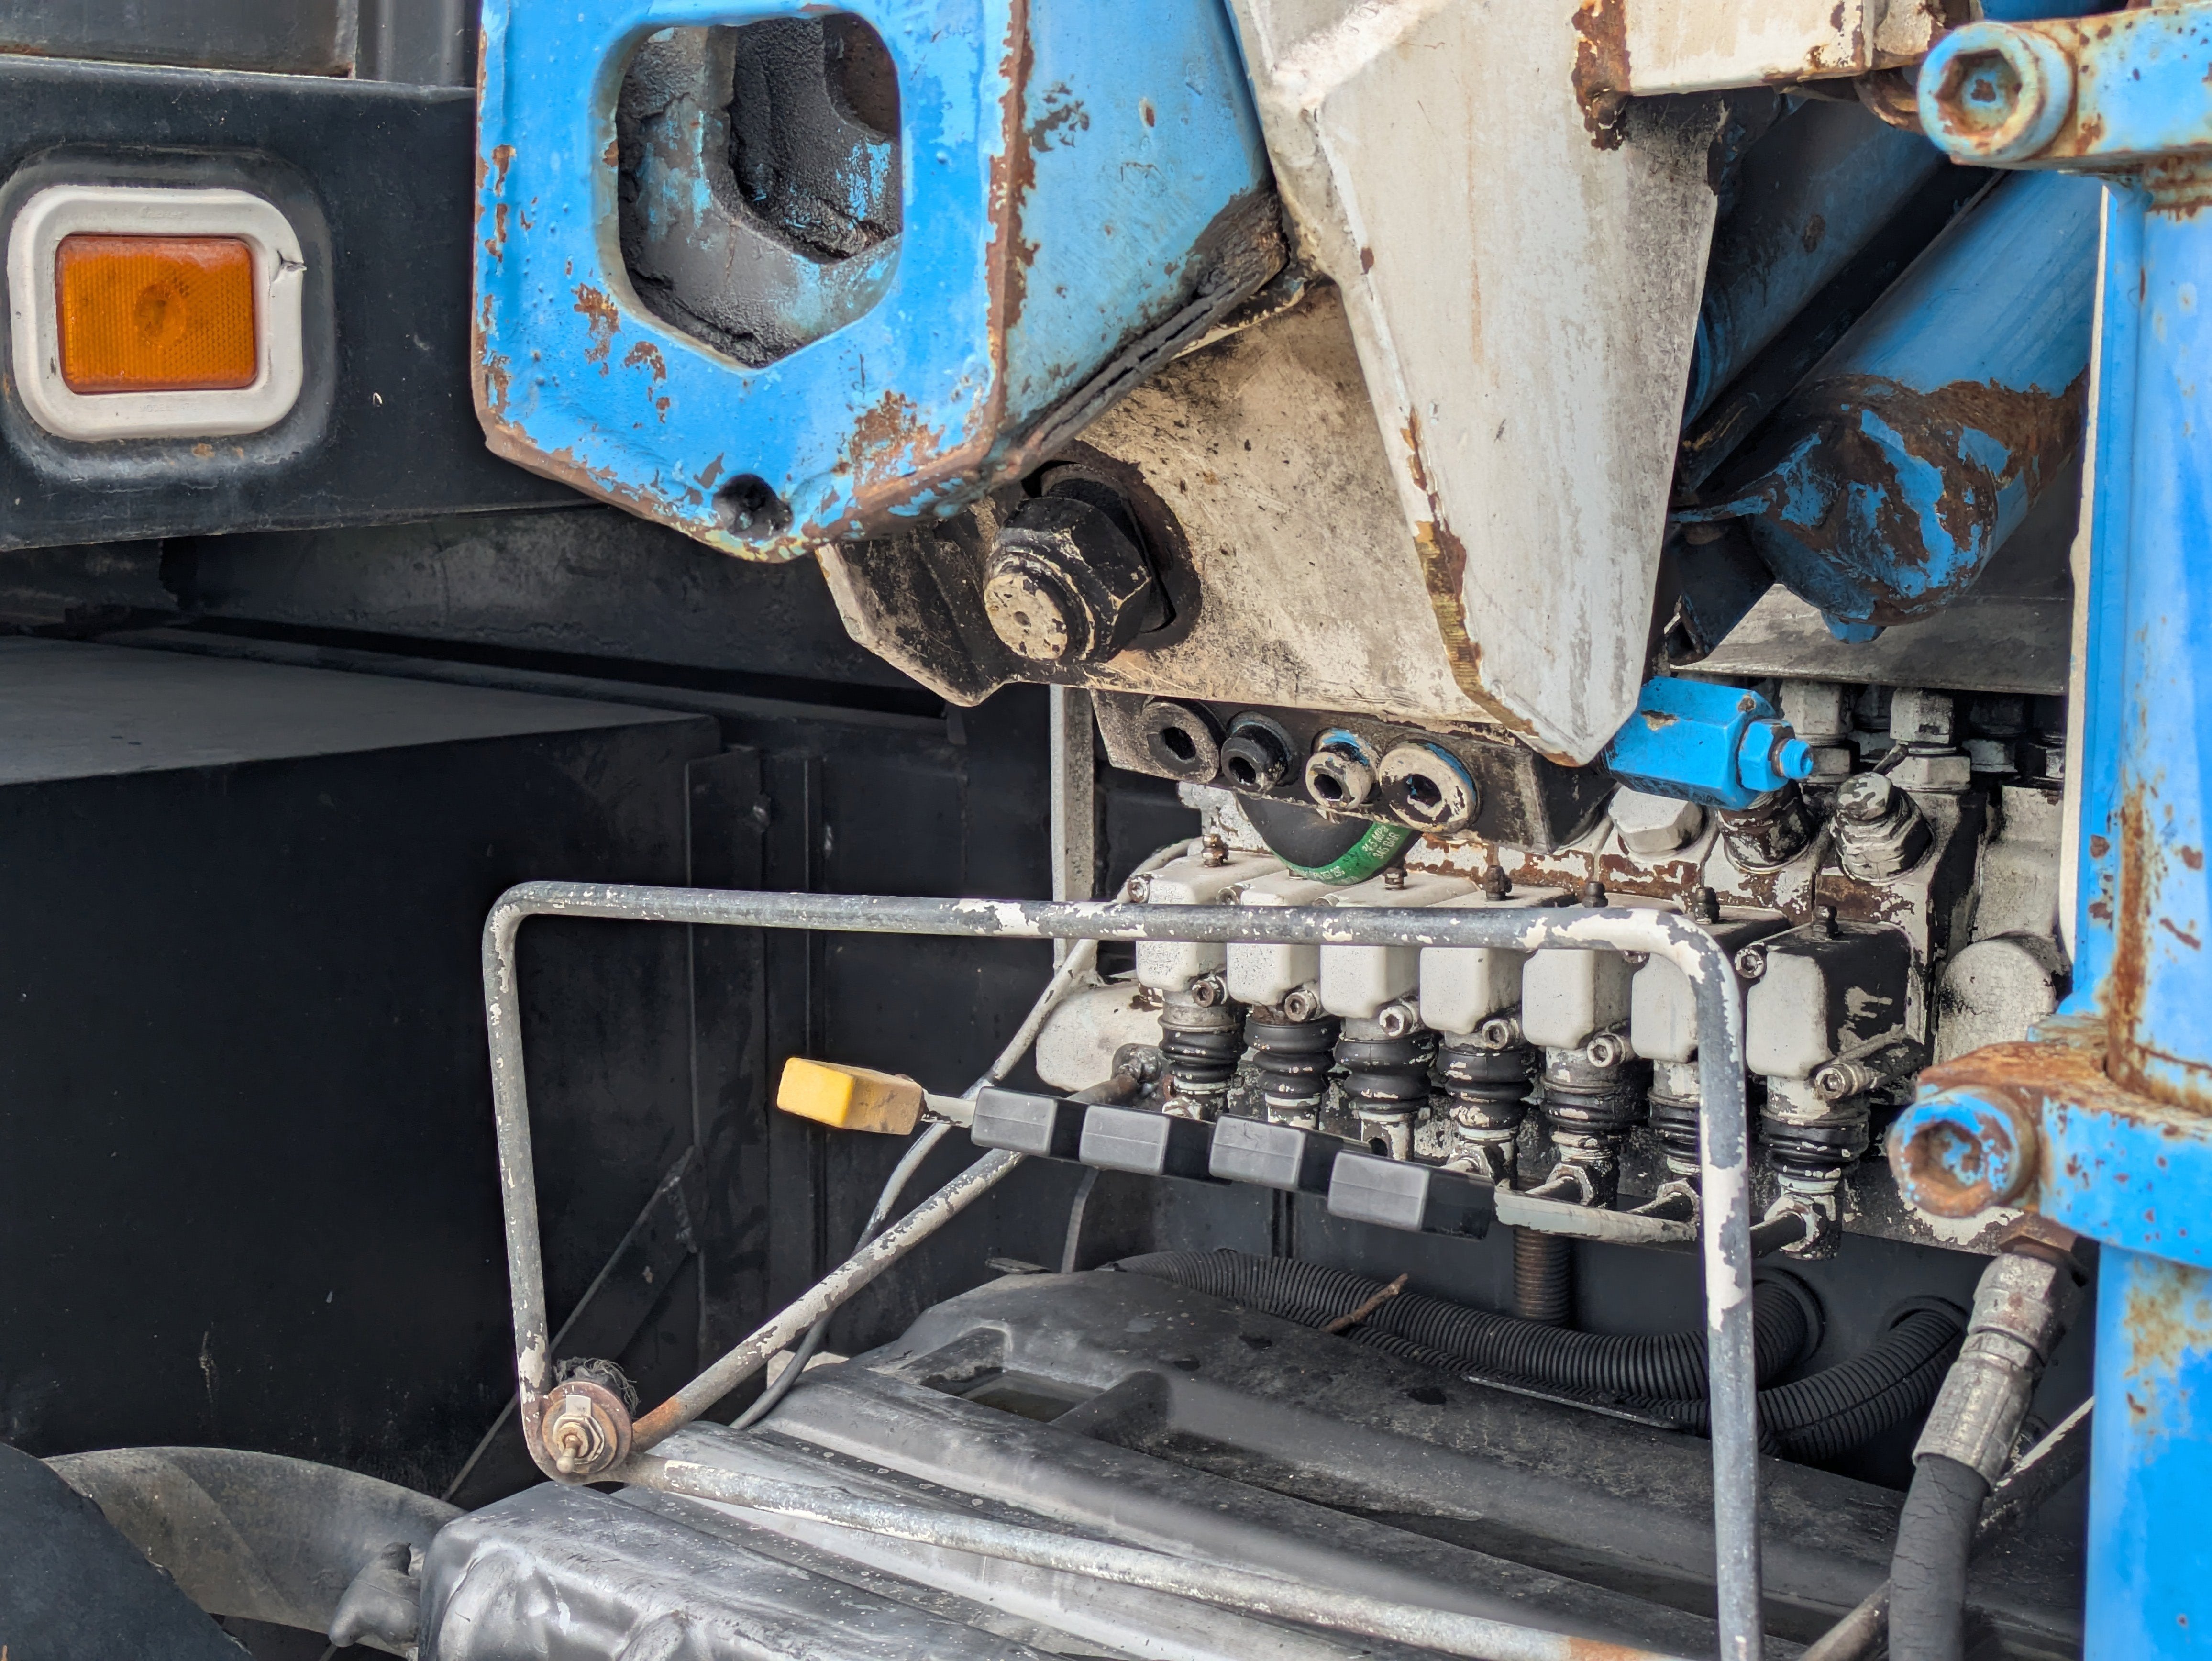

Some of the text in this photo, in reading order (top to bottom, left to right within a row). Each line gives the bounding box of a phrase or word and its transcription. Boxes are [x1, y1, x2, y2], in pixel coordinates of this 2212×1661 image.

[1371, 825, 1390, 842] MPa
[1373, 832, 1401, 859] 345 BAR
